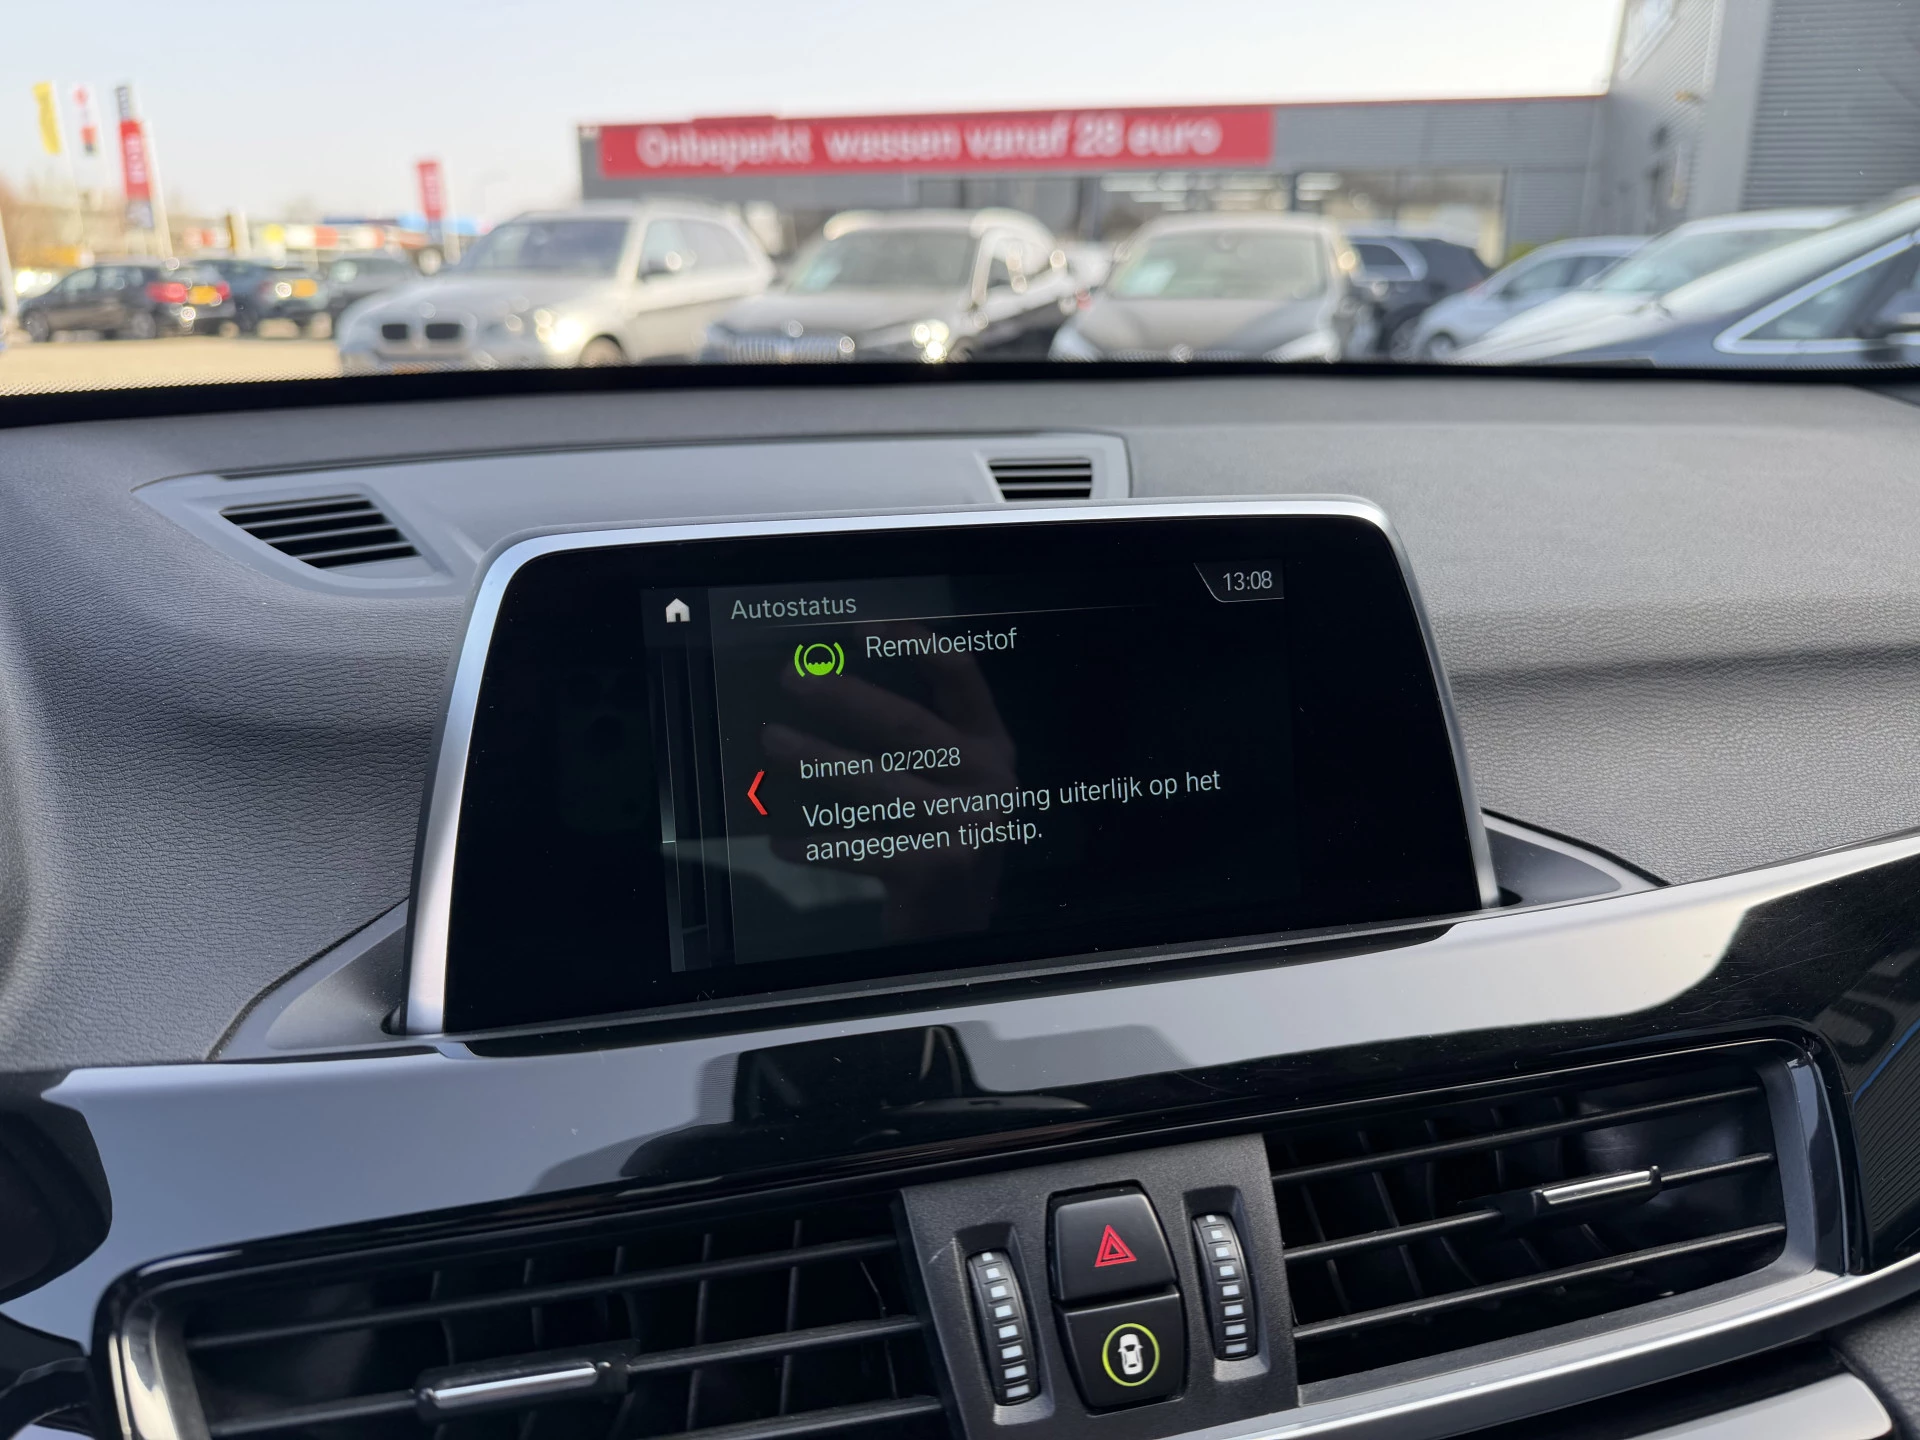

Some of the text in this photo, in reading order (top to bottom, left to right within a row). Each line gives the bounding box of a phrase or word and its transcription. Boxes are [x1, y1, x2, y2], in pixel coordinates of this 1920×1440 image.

[639, 112, 1221, 170] Onbeperkt wassen vanaf 28 euro
[1222, 570, 1273, 591] 13:08
[730, 596, 857, 620] Autostatus
[865, 627, 1018, 659] Remvloeistof
[800, 746, 961, 779] binnen 02/2028
[802, 770, 1221, 829] Volgende vervanging uiterlijk op het
[806, 818, 1042, 862] aangegeven tijdstip.
